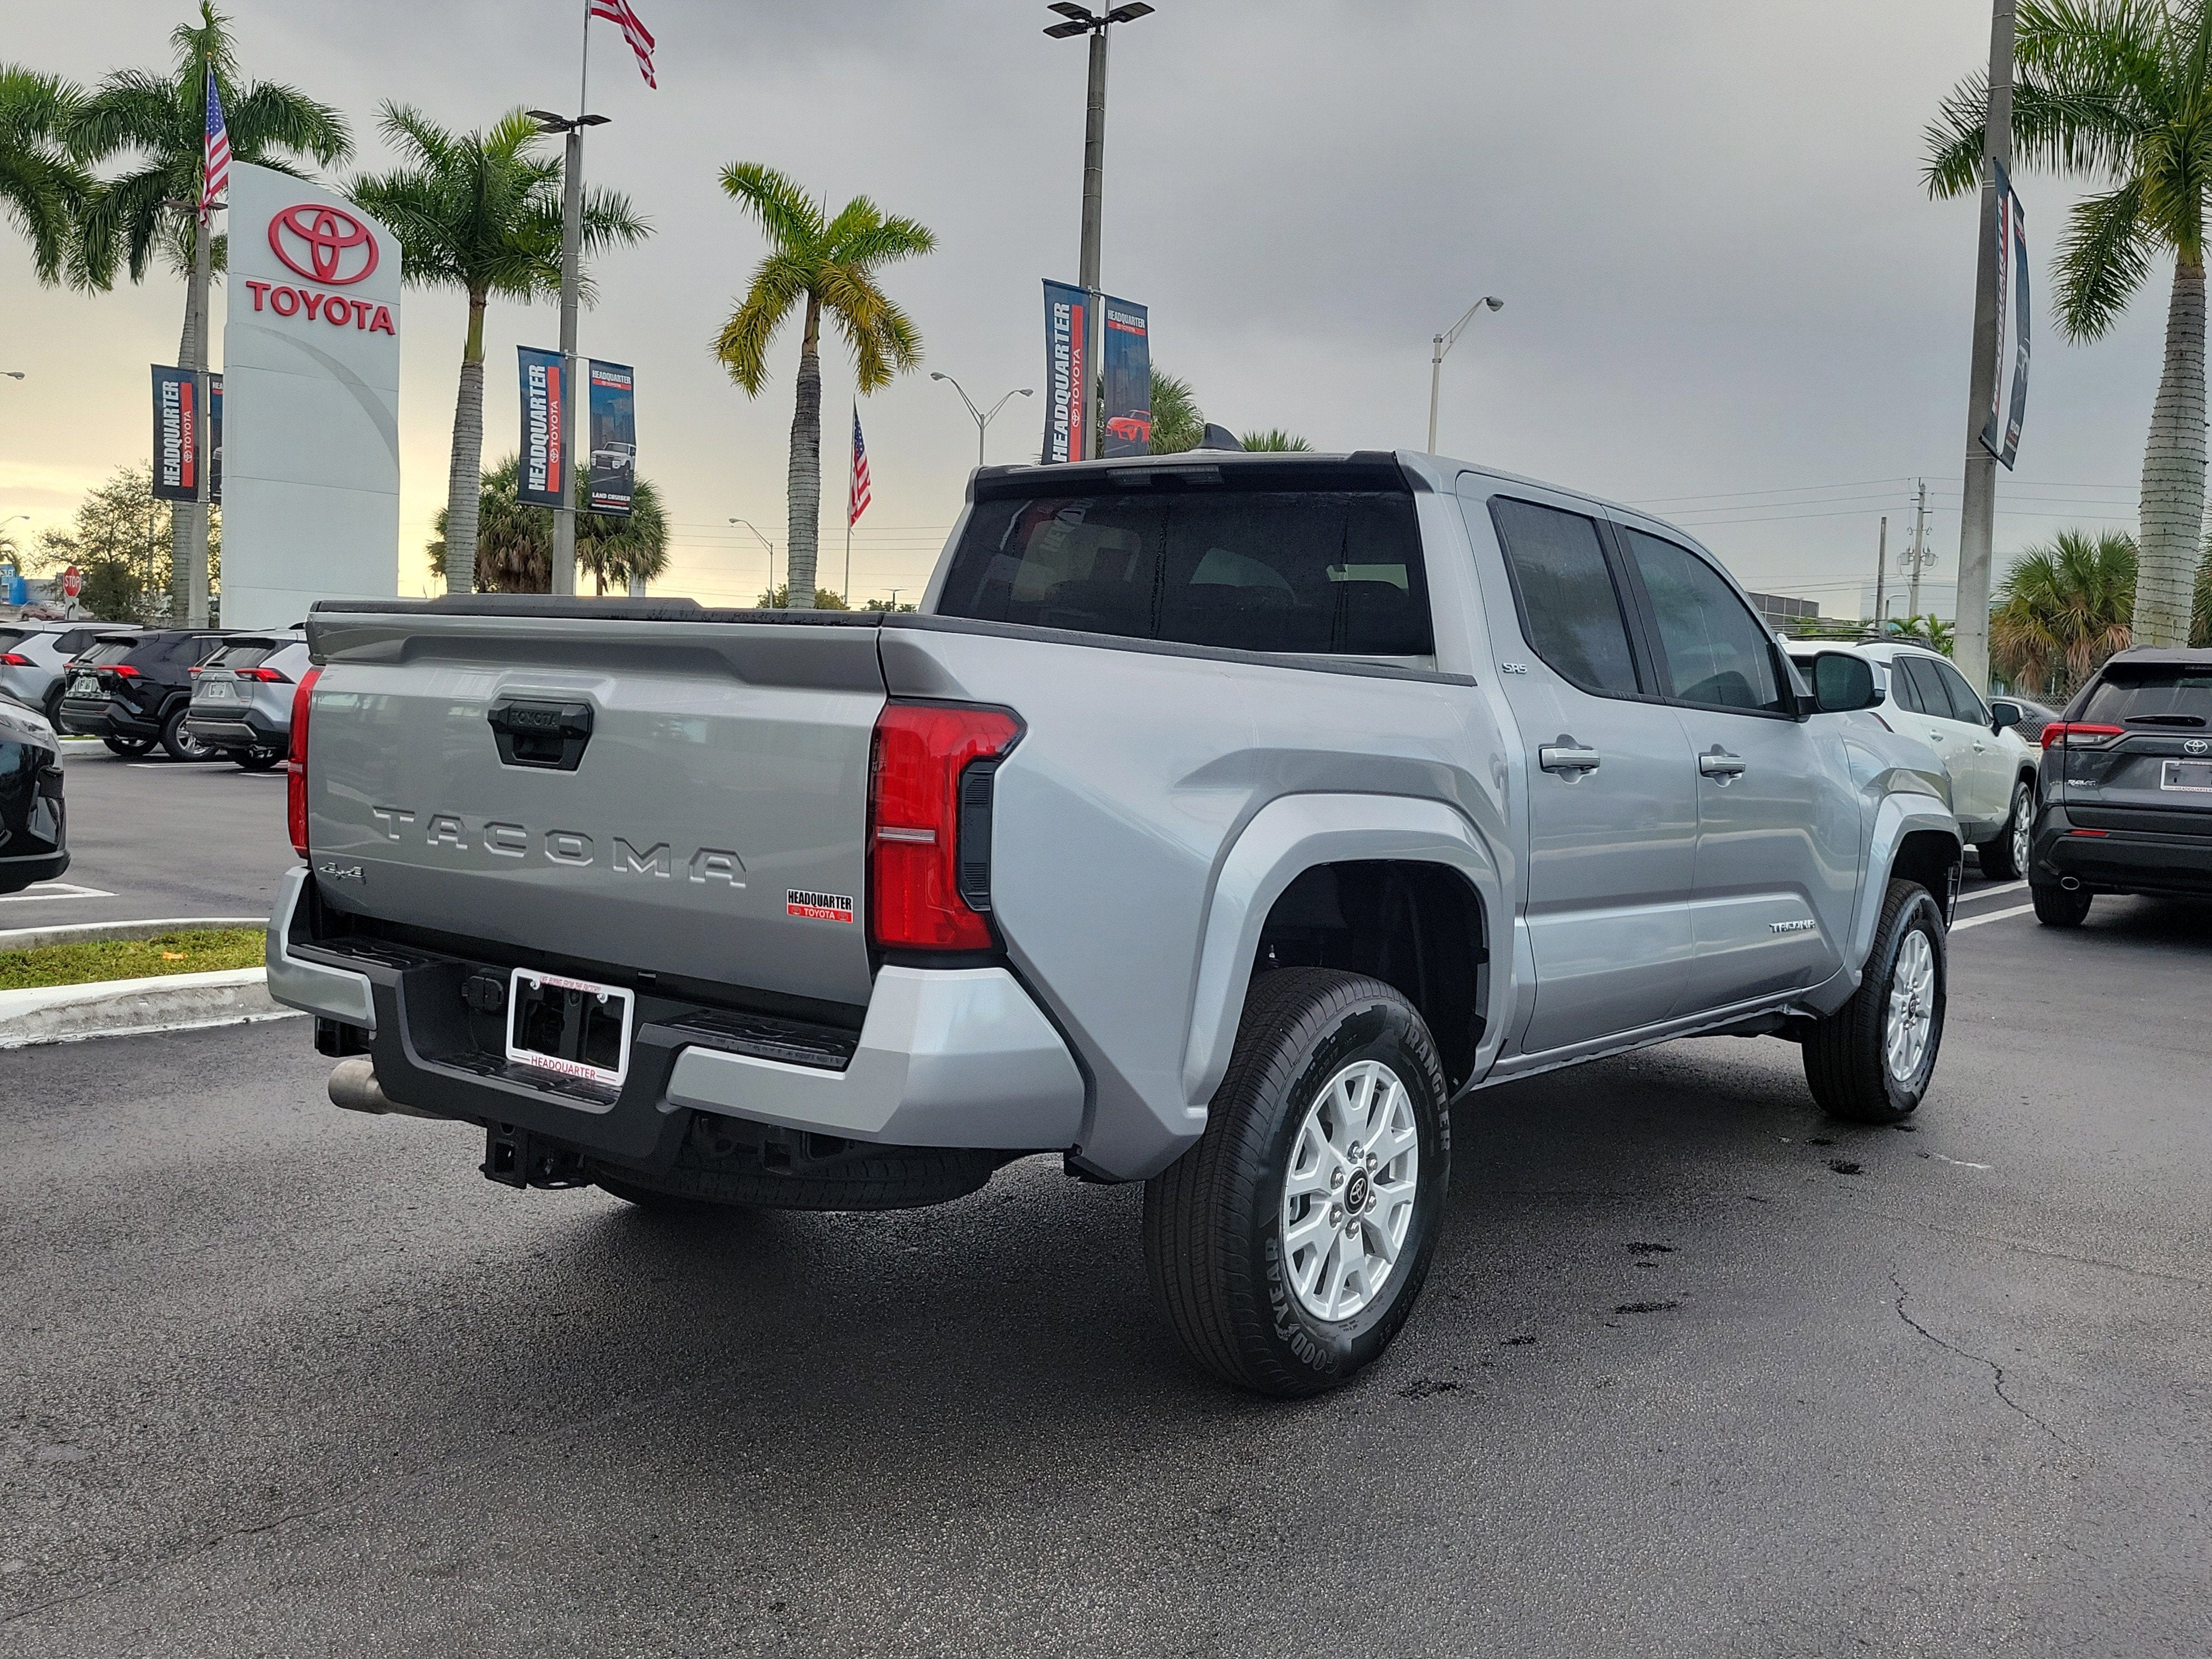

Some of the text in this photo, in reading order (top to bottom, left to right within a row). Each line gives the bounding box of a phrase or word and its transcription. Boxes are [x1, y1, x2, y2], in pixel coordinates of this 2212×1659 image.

[246, 280, 396, 335] TOYOTA
[1108, 309, 1145, 329] HEADQUARTER
[592, 370, 631, 385] HEADQUARTER
[1052, 302, 1071, 462] HEADQUARTER
[163, 381, 182, 486] HEADQUARTER
[184, 411, 192, 449] TOYOTA
[529, 365, 549, 491] HEADQUARTER
[65, 575, 80, 587] STOP
[1502, 663, 1527, 674] SR5
[511, 710, 558, 727] TOYOTA
[373, 805, 747, 888] TACOMA
[788, 890, 852, 911] HEADQUARTER
[804, 908, 835, 919] TOYOTA
[1769, 919, 1816, 933] TACOMA
[531, 1056, 596, 1080] HEADQUARTER
